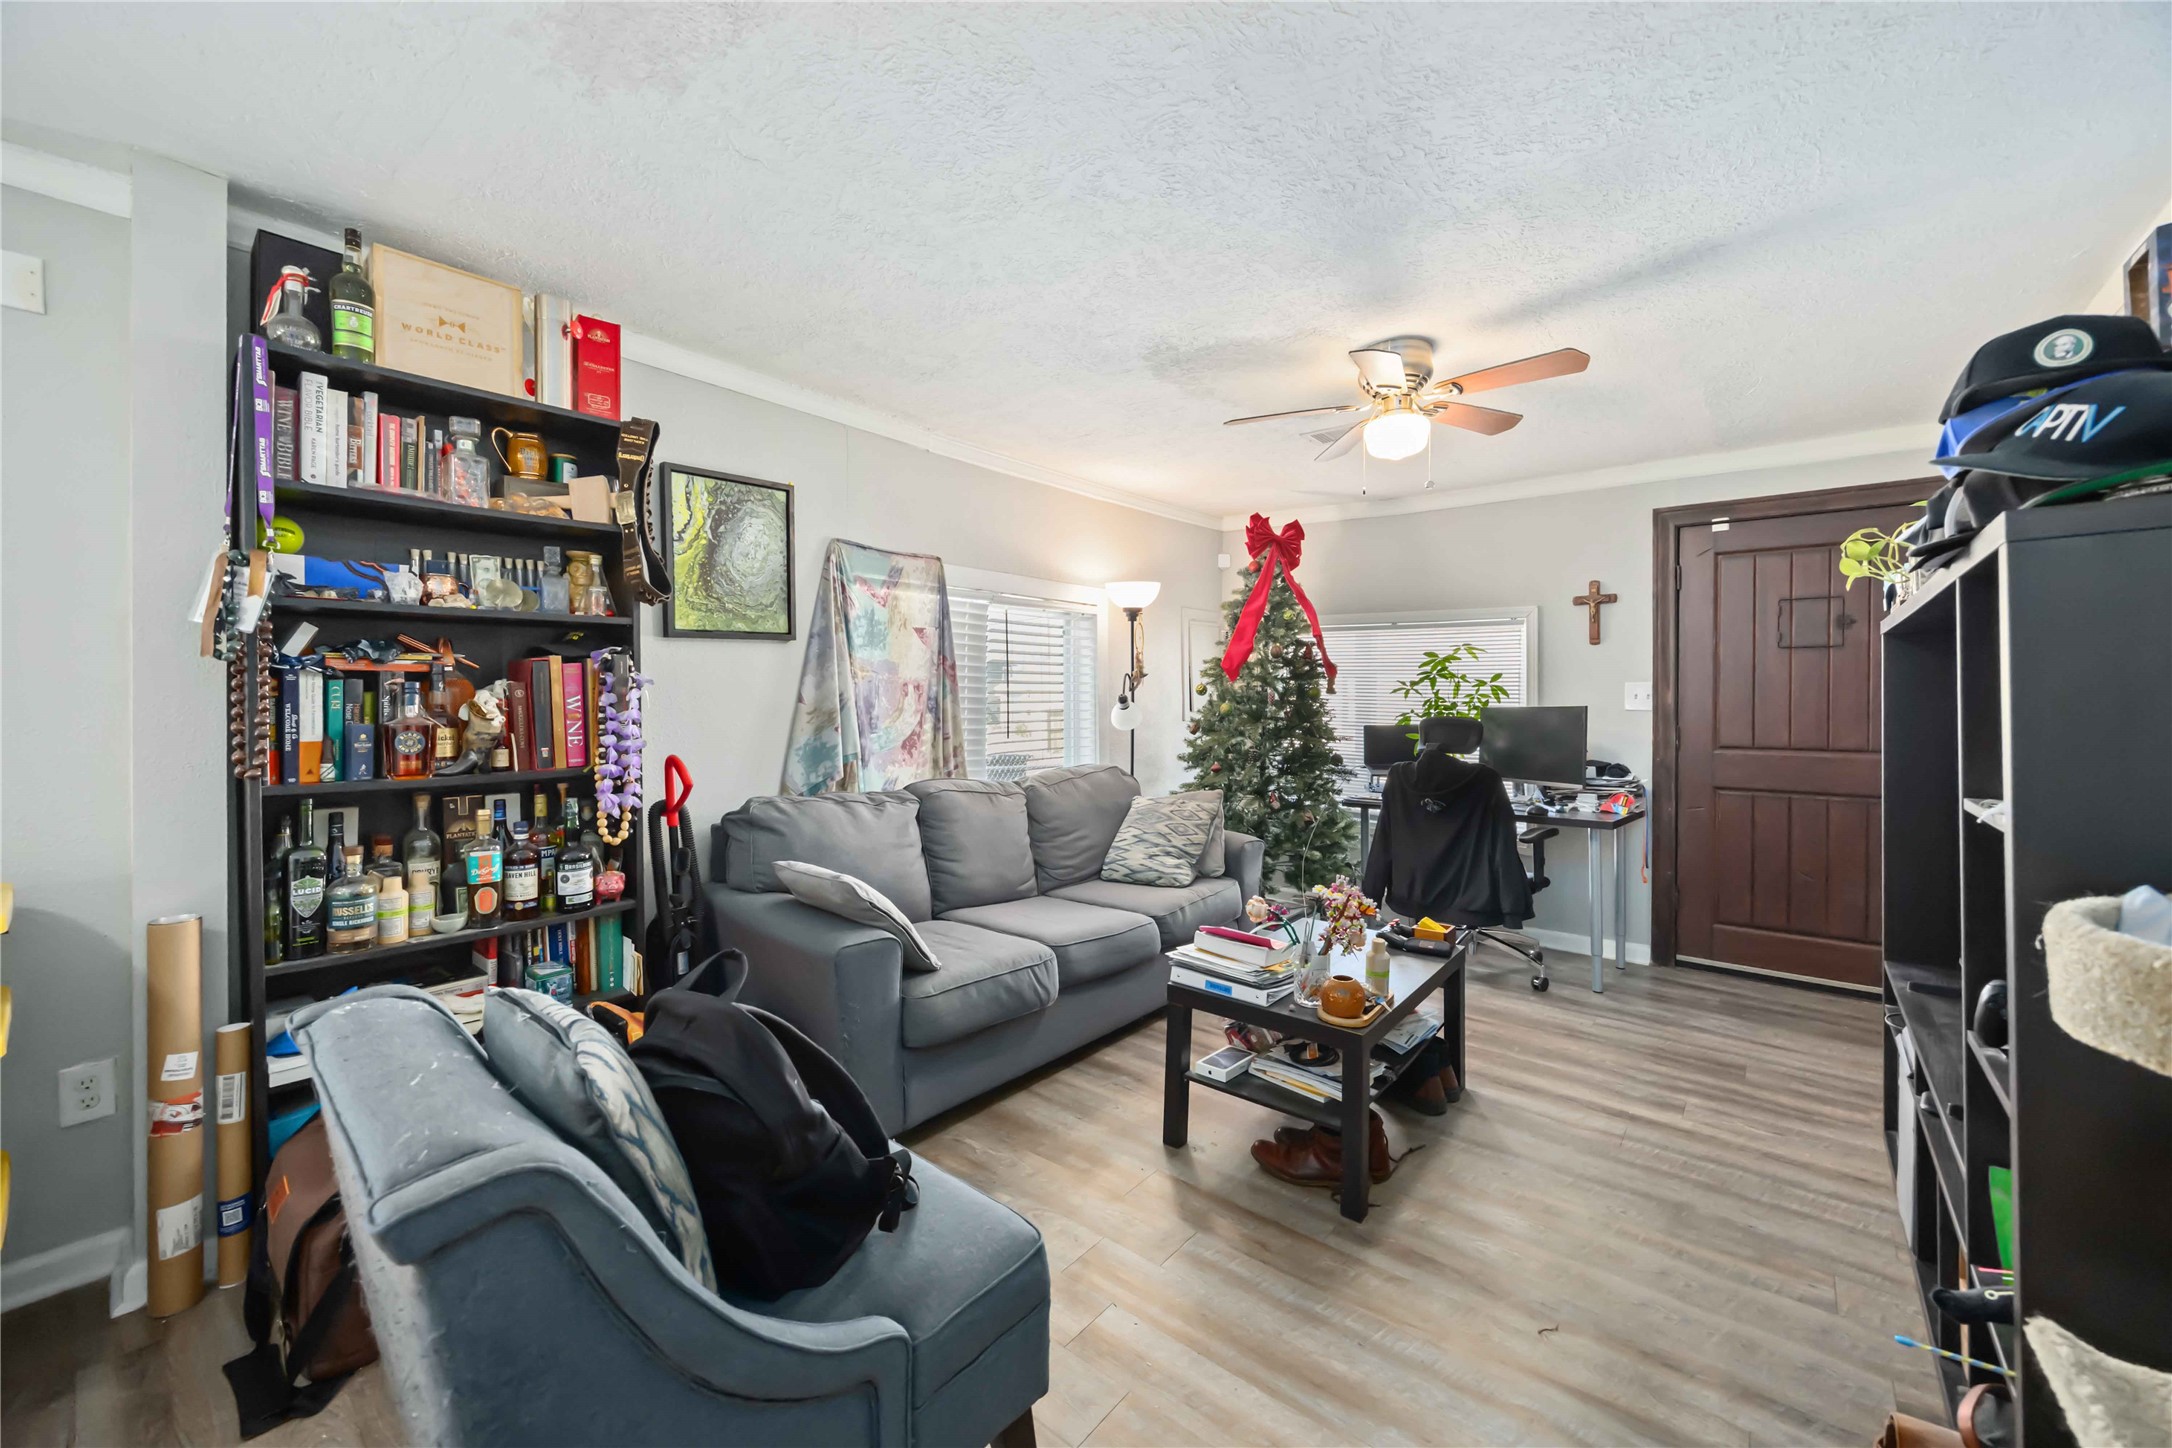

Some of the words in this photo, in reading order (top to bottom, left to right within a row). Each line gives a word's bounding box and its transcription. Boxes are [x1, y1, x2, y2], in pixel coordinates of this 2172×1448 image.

[334, 304, 373, 317] CHARTREUSE
[401, 322, 453, 341] WORLD
[459, 337, 501, 353] CLASS
[303, 379, 313, 410] FLAVOR
[277, 400, 293, 430] WINE
[315, 385, 324, 434] VEGETARIAN
[303, 410, 313, 432] BIBLE
[345, 703, 353, 720] Nose
[523, 870, 537, 878] HILL
[292, 887, 321, 895] LUCID
[332, 903, 374, 916] RUSSELL'S
